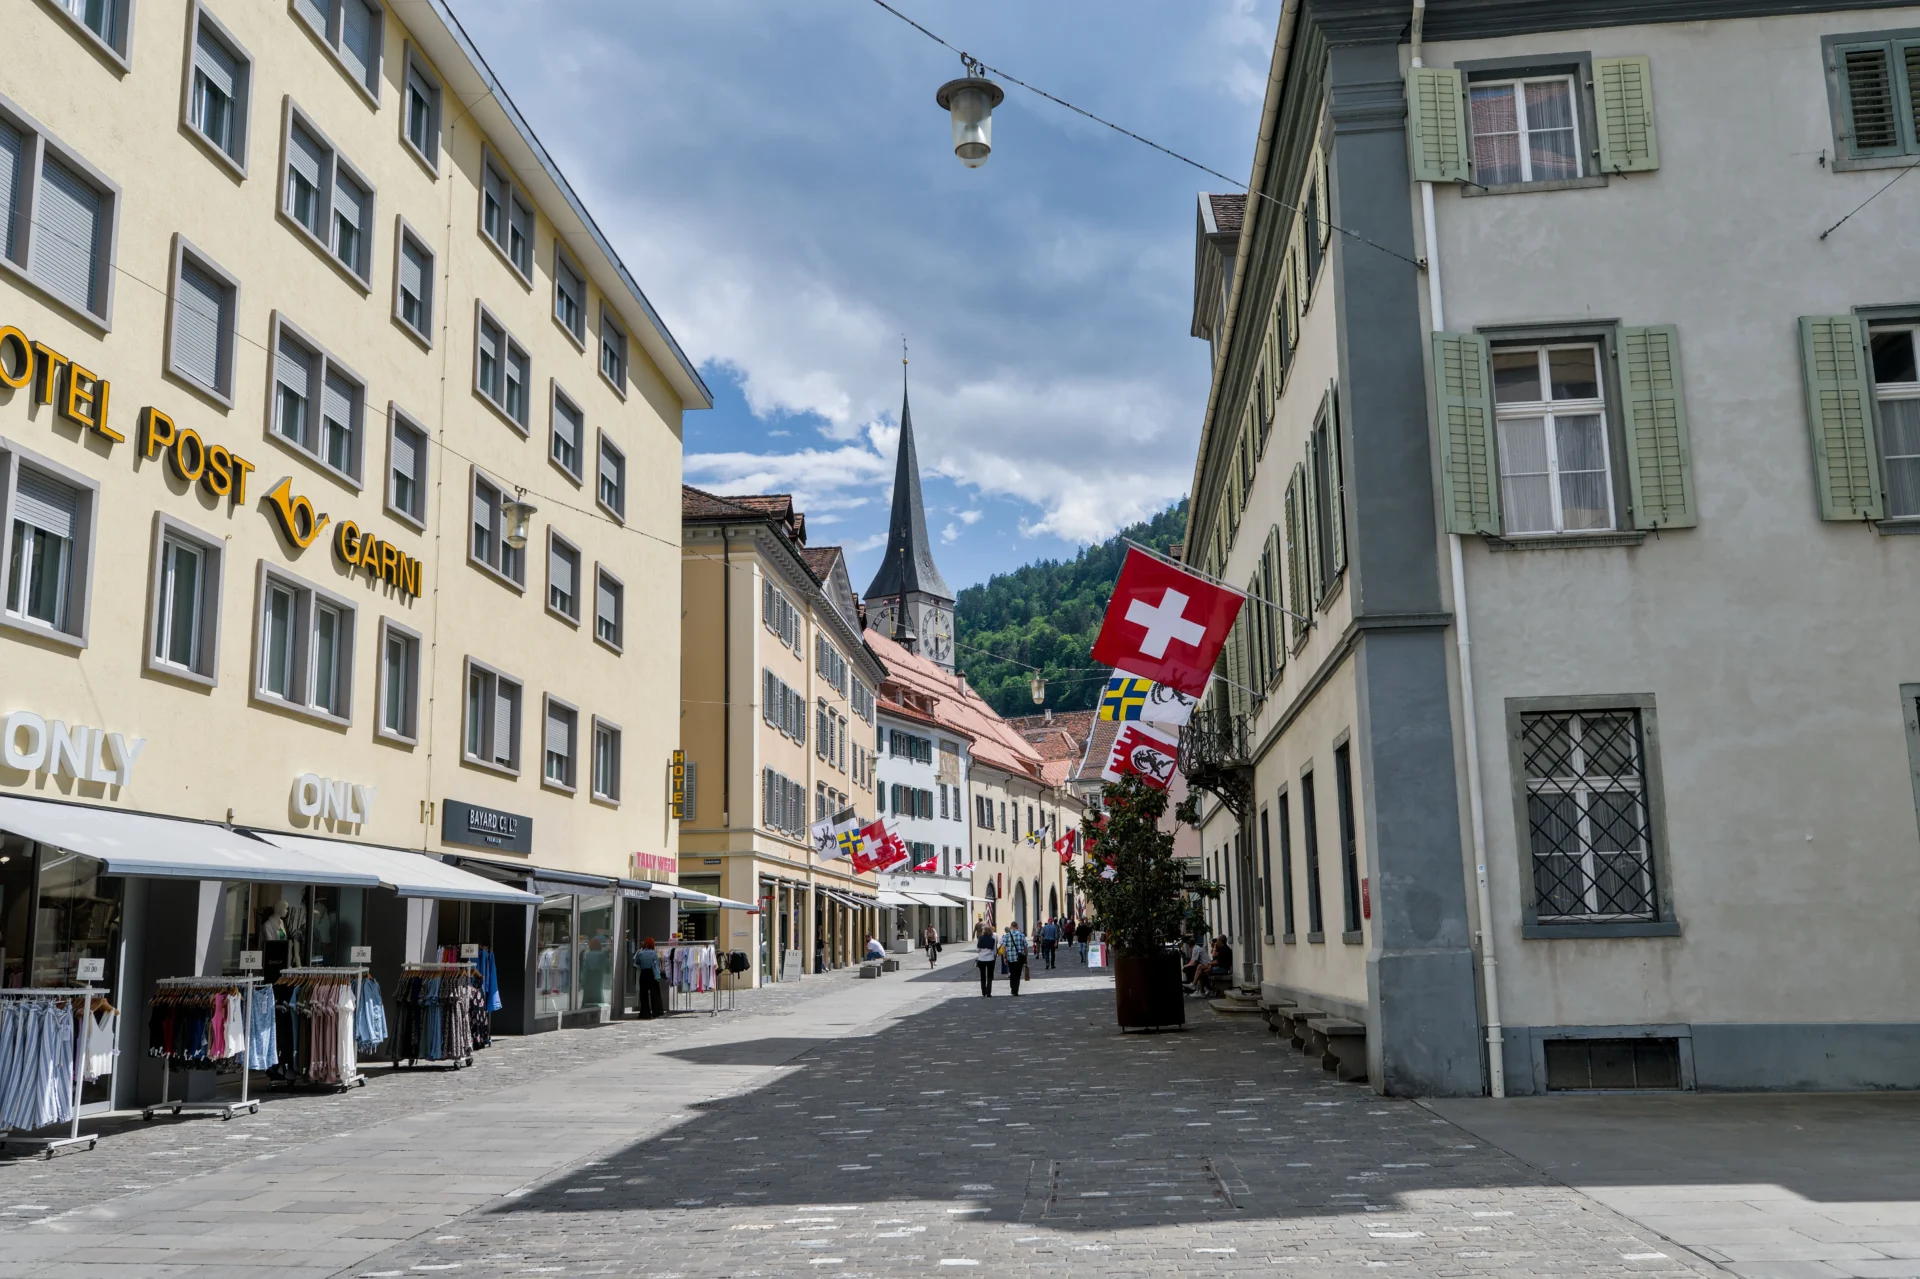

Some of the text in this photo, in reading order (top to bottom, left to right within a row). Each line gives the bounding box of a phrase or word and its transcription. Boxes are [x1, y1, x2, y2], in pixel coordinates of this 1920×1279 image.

[140, 405, 256, 506] POST
[334, 519, 422, 599] GARNI
[1, 710, 147, 787] ONLY
[292, 772, 378, 825] ONLY
[673, 751, 684, 817] HOTEL
[469, 809, 498, 829] BAYARD
[636, 851, 657, 870] TALLY
